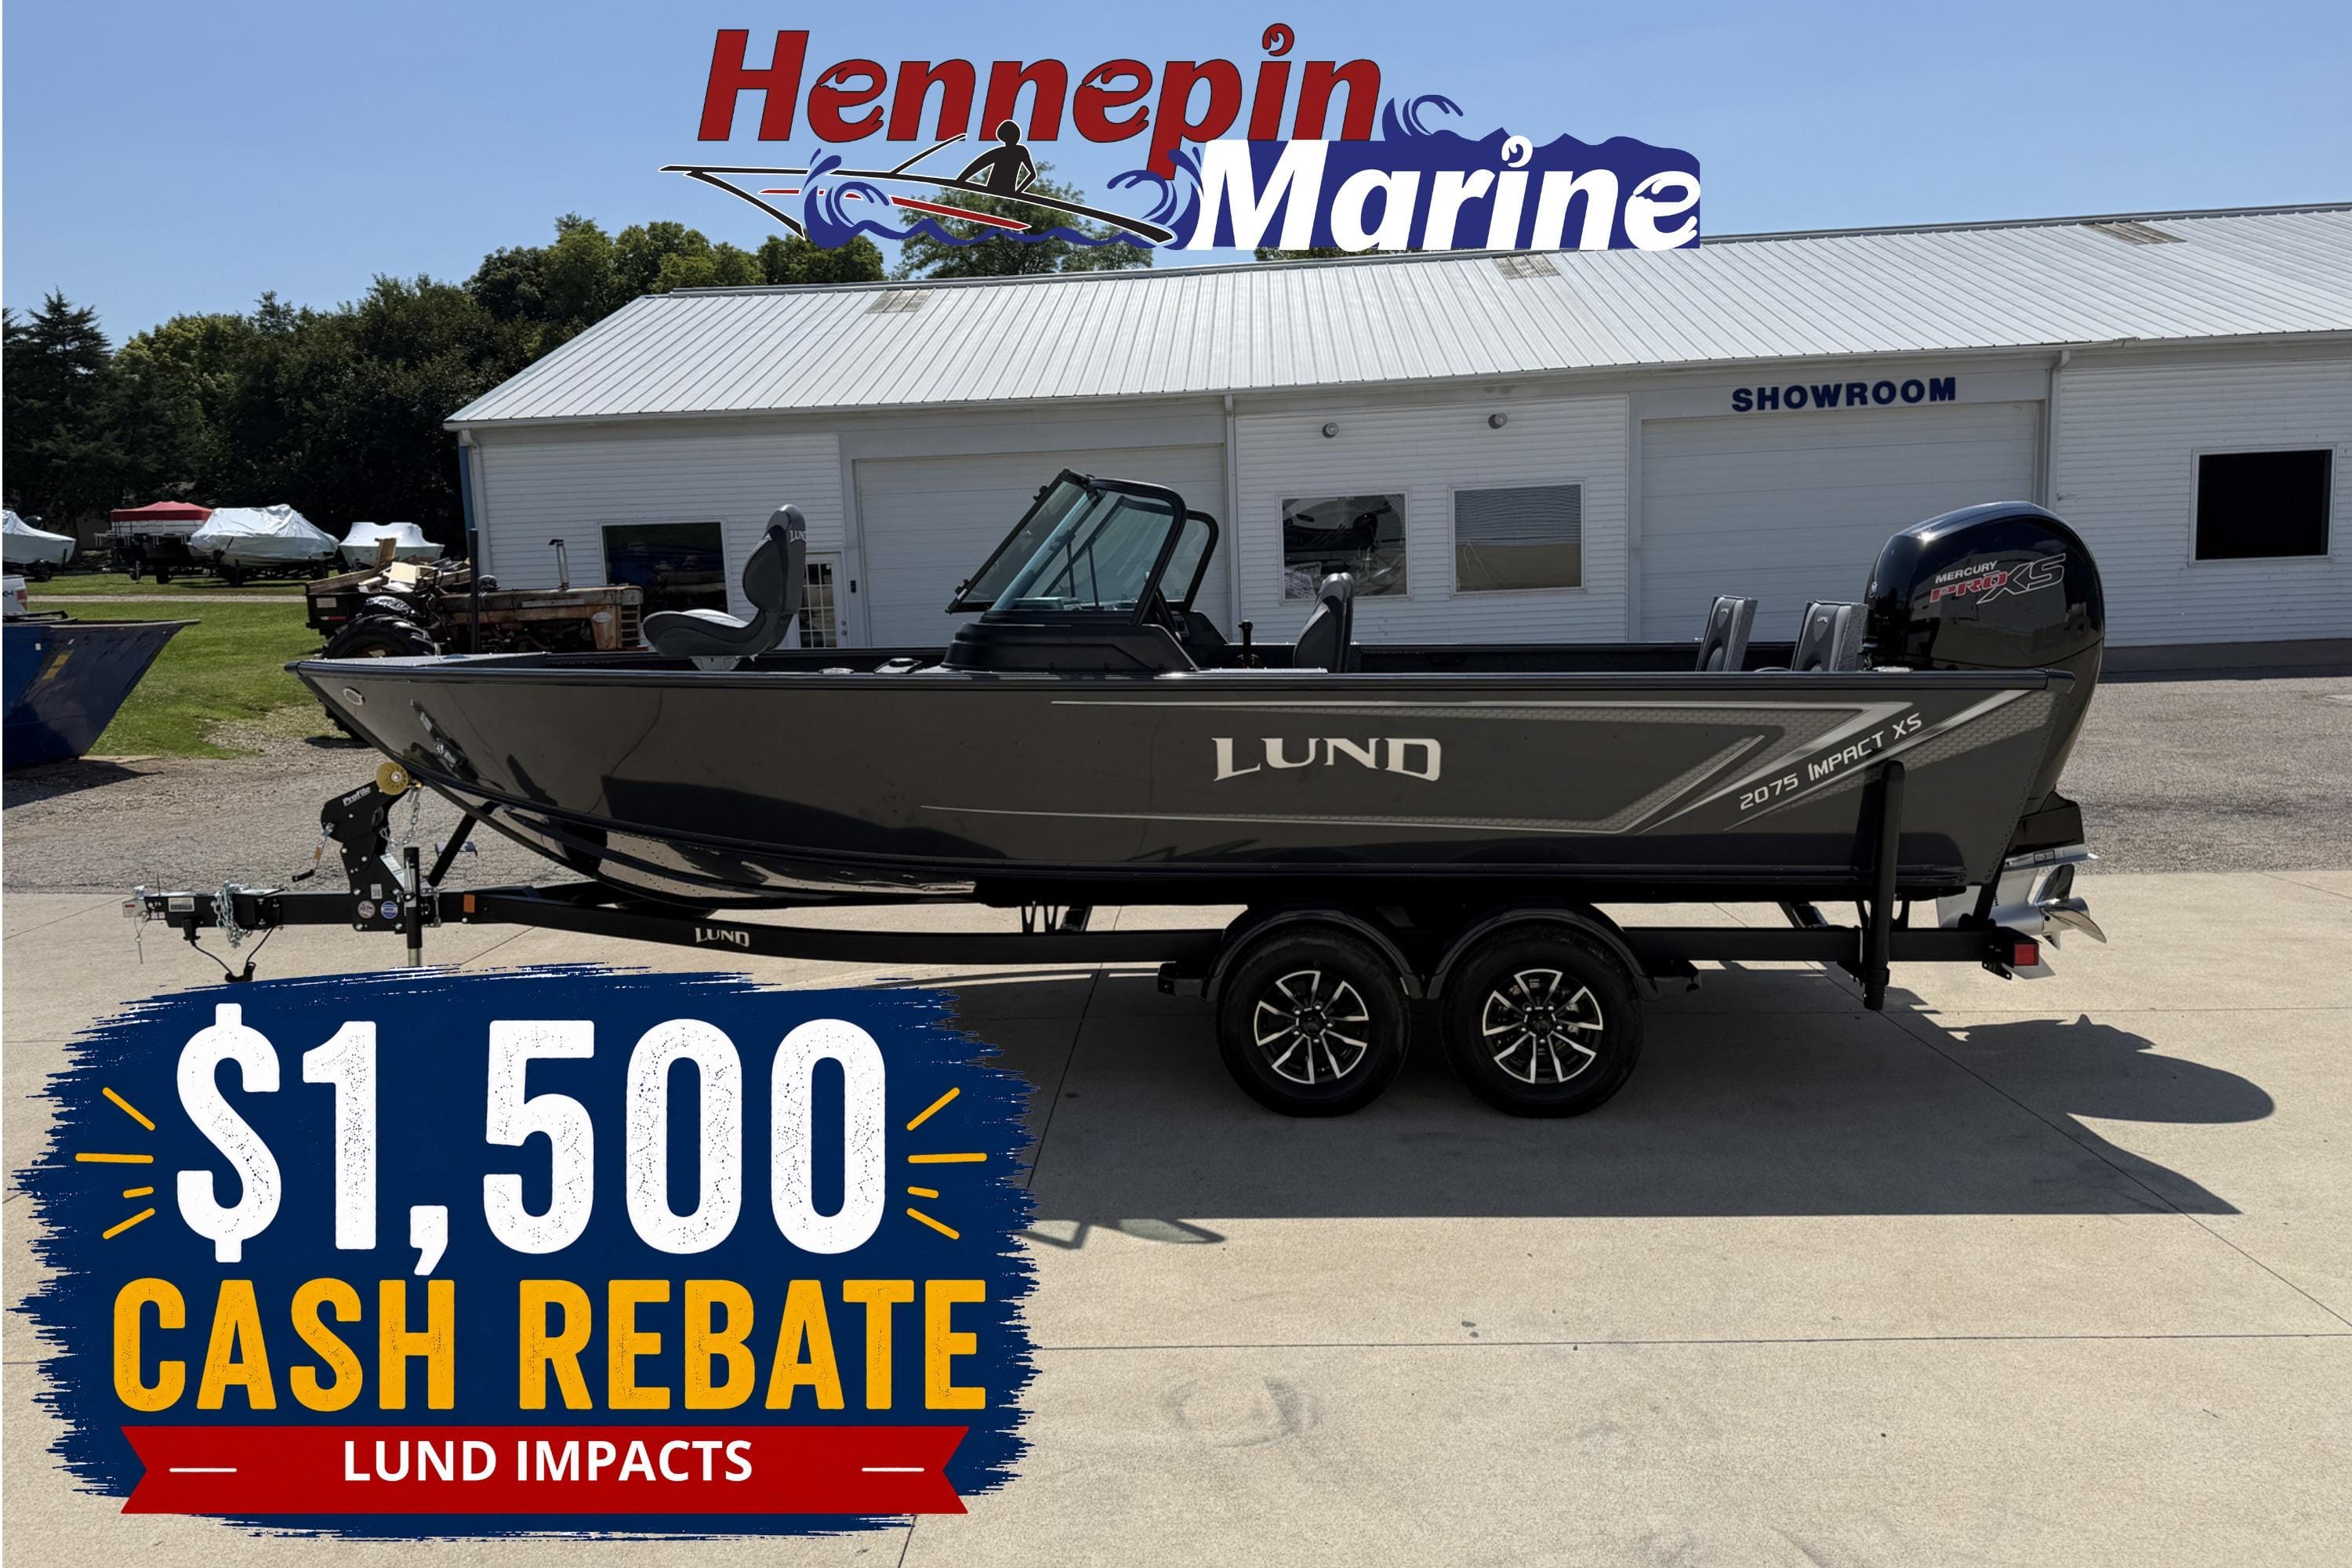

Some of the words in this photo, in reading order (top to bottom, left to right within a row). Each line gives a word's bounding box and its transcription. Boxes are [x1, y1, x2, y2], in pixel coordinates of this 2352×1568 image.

[1731, 377, 1956, 412] SHOWROOM
[1929, 571, 2008, 604] PRO
[1935, 560, 1998, 584] MERCURY
[1211, 737, 1442, 782] LUND
[1739, 772, 1799, 811] 2075
[1807, 730, 1885, 782] IMPACT
[1891, 712, 1922, 741] XS
[695, 927, 750, 948] LUND
